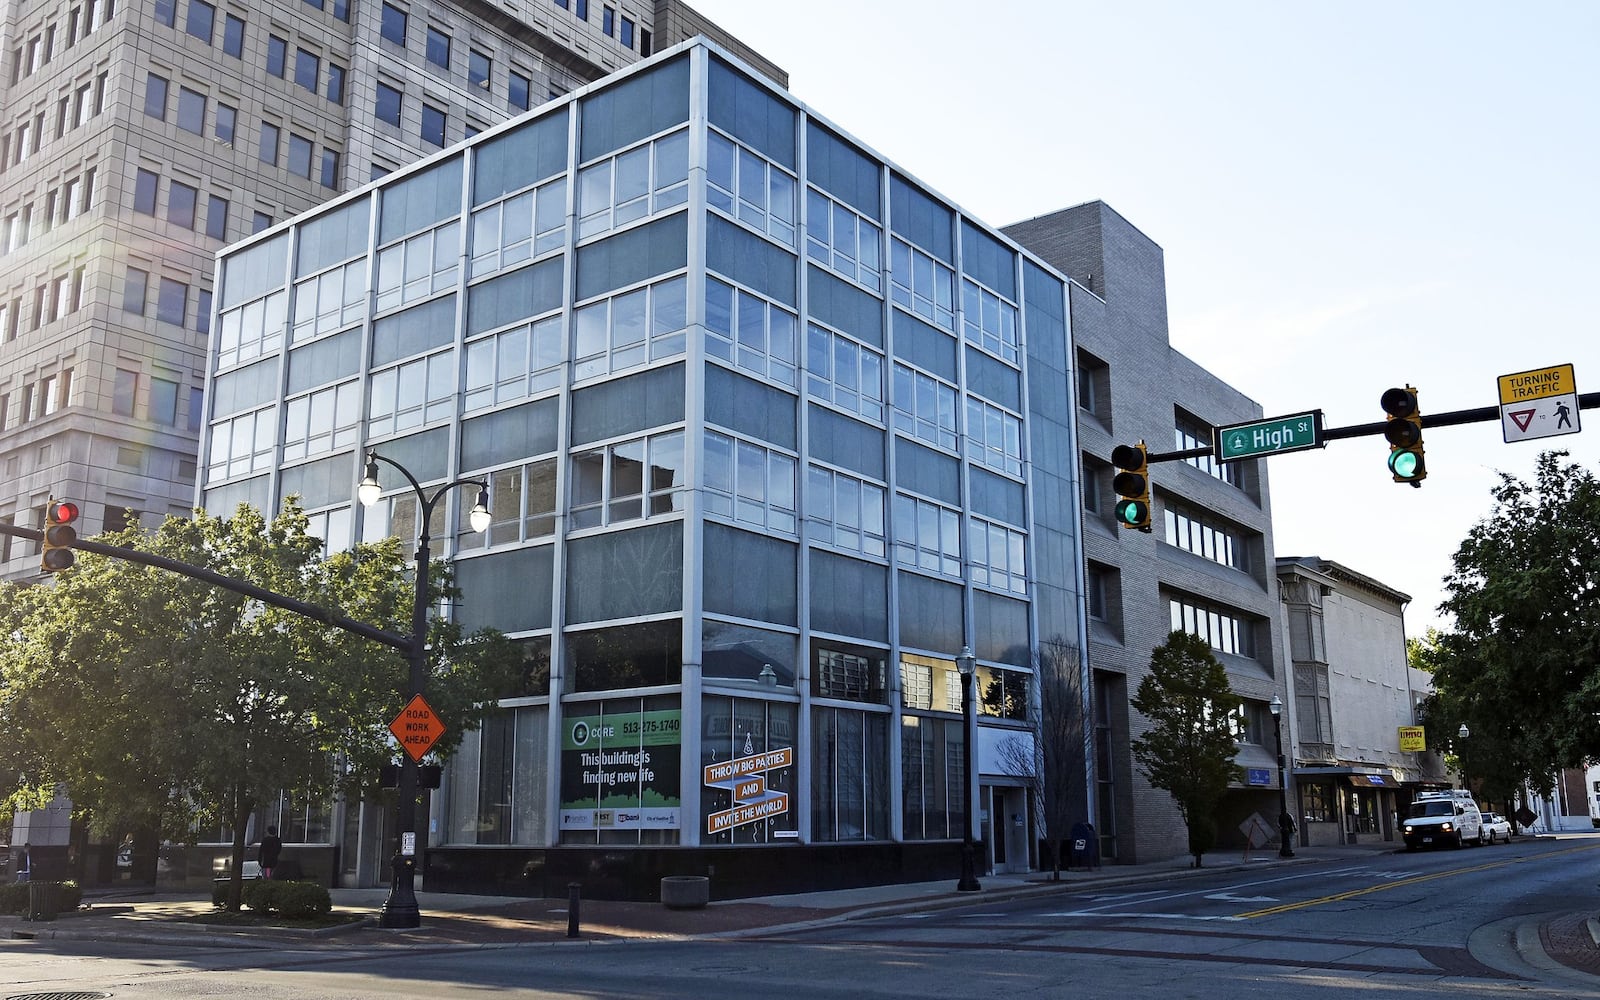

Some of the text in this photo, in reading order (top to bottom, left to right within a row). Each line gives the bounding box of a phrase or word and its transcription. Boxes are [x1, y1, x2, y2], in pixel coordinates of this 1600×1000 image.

[1509, 371, 1560, 388] TURNING
[1512, 382, 1560, 398] TRAFFIC
[1253, 422, 1308, 449] High St
[406, 710, 430, 719] ROAD
[405, 722, 429, 731] WORK
[403, 735, 430, 744] AHEAD
[581, 750, 651, 766] This building is
[710, 752, 785, 780] THROW BIG PARTIES
[617, 771, 637, 783] new
[741, 783, 759, 797] AND
[740, 809, 755, 821] THE
[755, 800, 783, 816] WORLD
